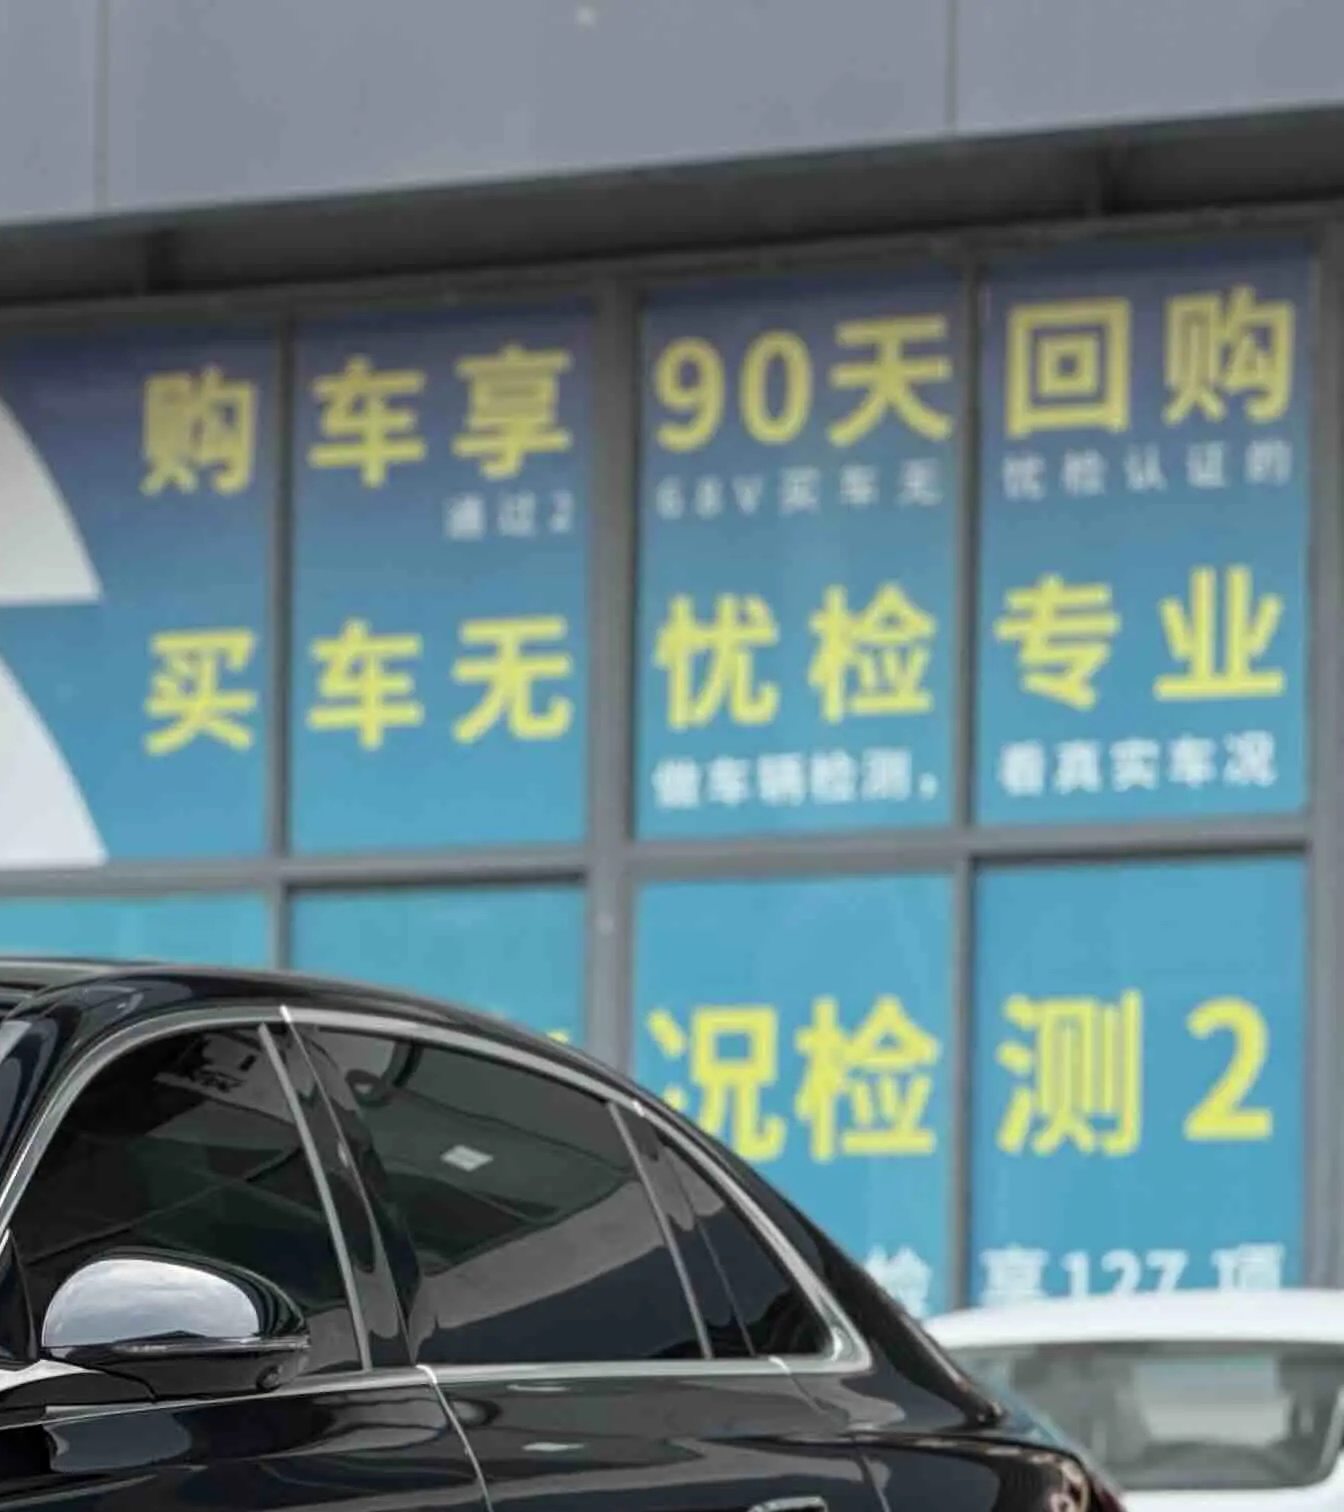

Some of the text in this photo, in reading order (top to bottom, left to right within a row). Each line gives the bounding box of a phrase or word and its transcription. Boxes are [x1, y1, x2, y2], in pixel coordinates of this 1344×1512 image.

[139, 285, 1295, 495] 购车享90天回购
